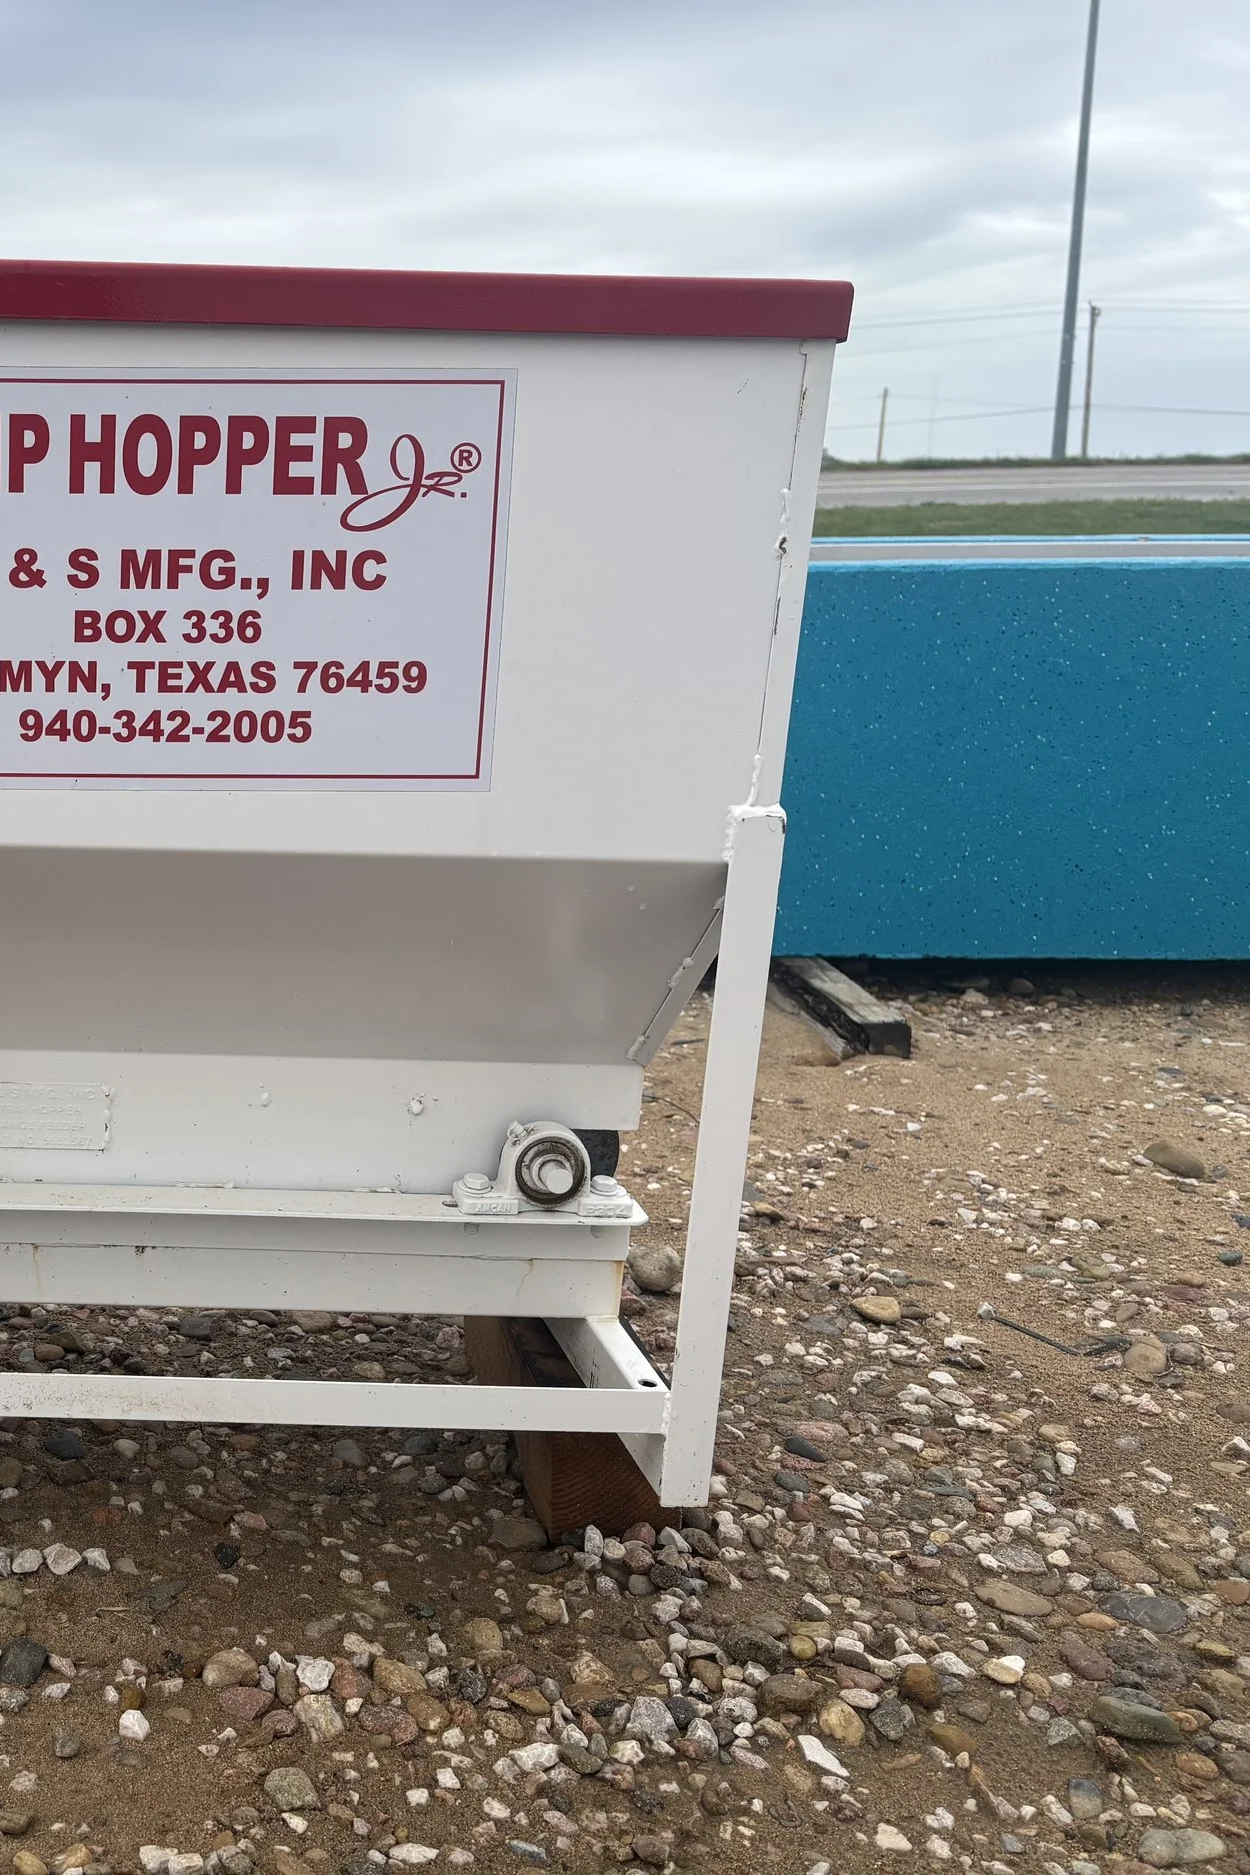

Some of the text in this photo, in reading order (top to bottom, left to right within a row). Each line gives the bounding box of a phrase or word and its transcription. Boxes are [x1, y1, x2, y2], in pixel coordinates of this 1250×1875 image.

[69, 414, 368, 495] HOPPER
[9, 548, 47, 589] &
[68, 548, 100, 589] S
[120, 549, 269, 600] MFG.,
[291, 550, 386, 591] INC
[74, 610, 262, 644] BOX 336
[127, 661, 276, 694] TEXAS
[294, 660, 427, 694] 76459
[19, 710, 312, 744] 940-342-2005
